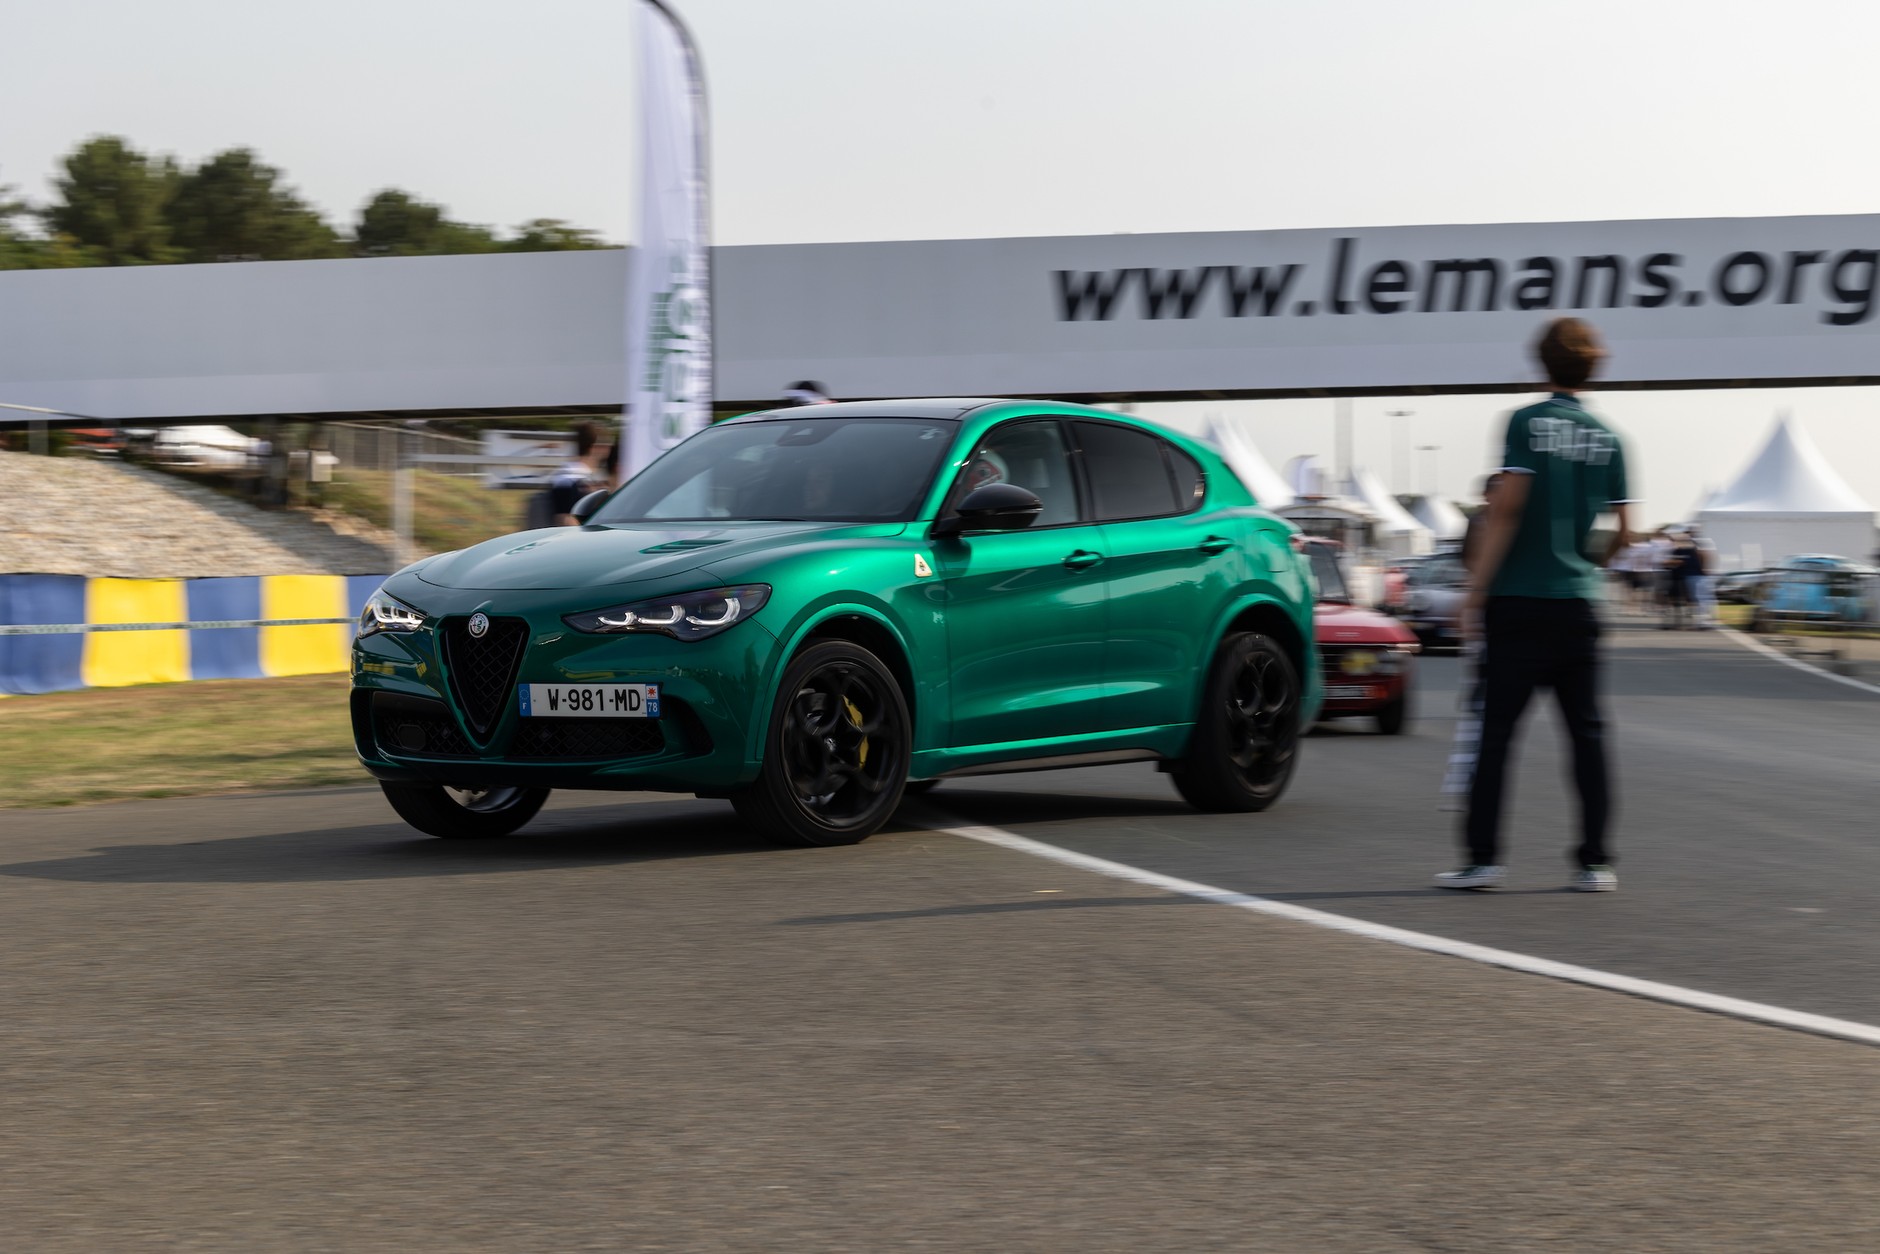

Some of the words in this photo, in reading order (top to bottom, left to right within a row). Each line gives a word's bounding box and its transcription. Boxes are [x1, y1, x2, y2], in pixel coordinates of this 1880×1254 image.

[1051, 237, 1880, 326] www.lemans.org
[522, 702, 527, 710] F
[547, 688, 641, 712] W-981-MD
[647, 702, 658, 713] 78
